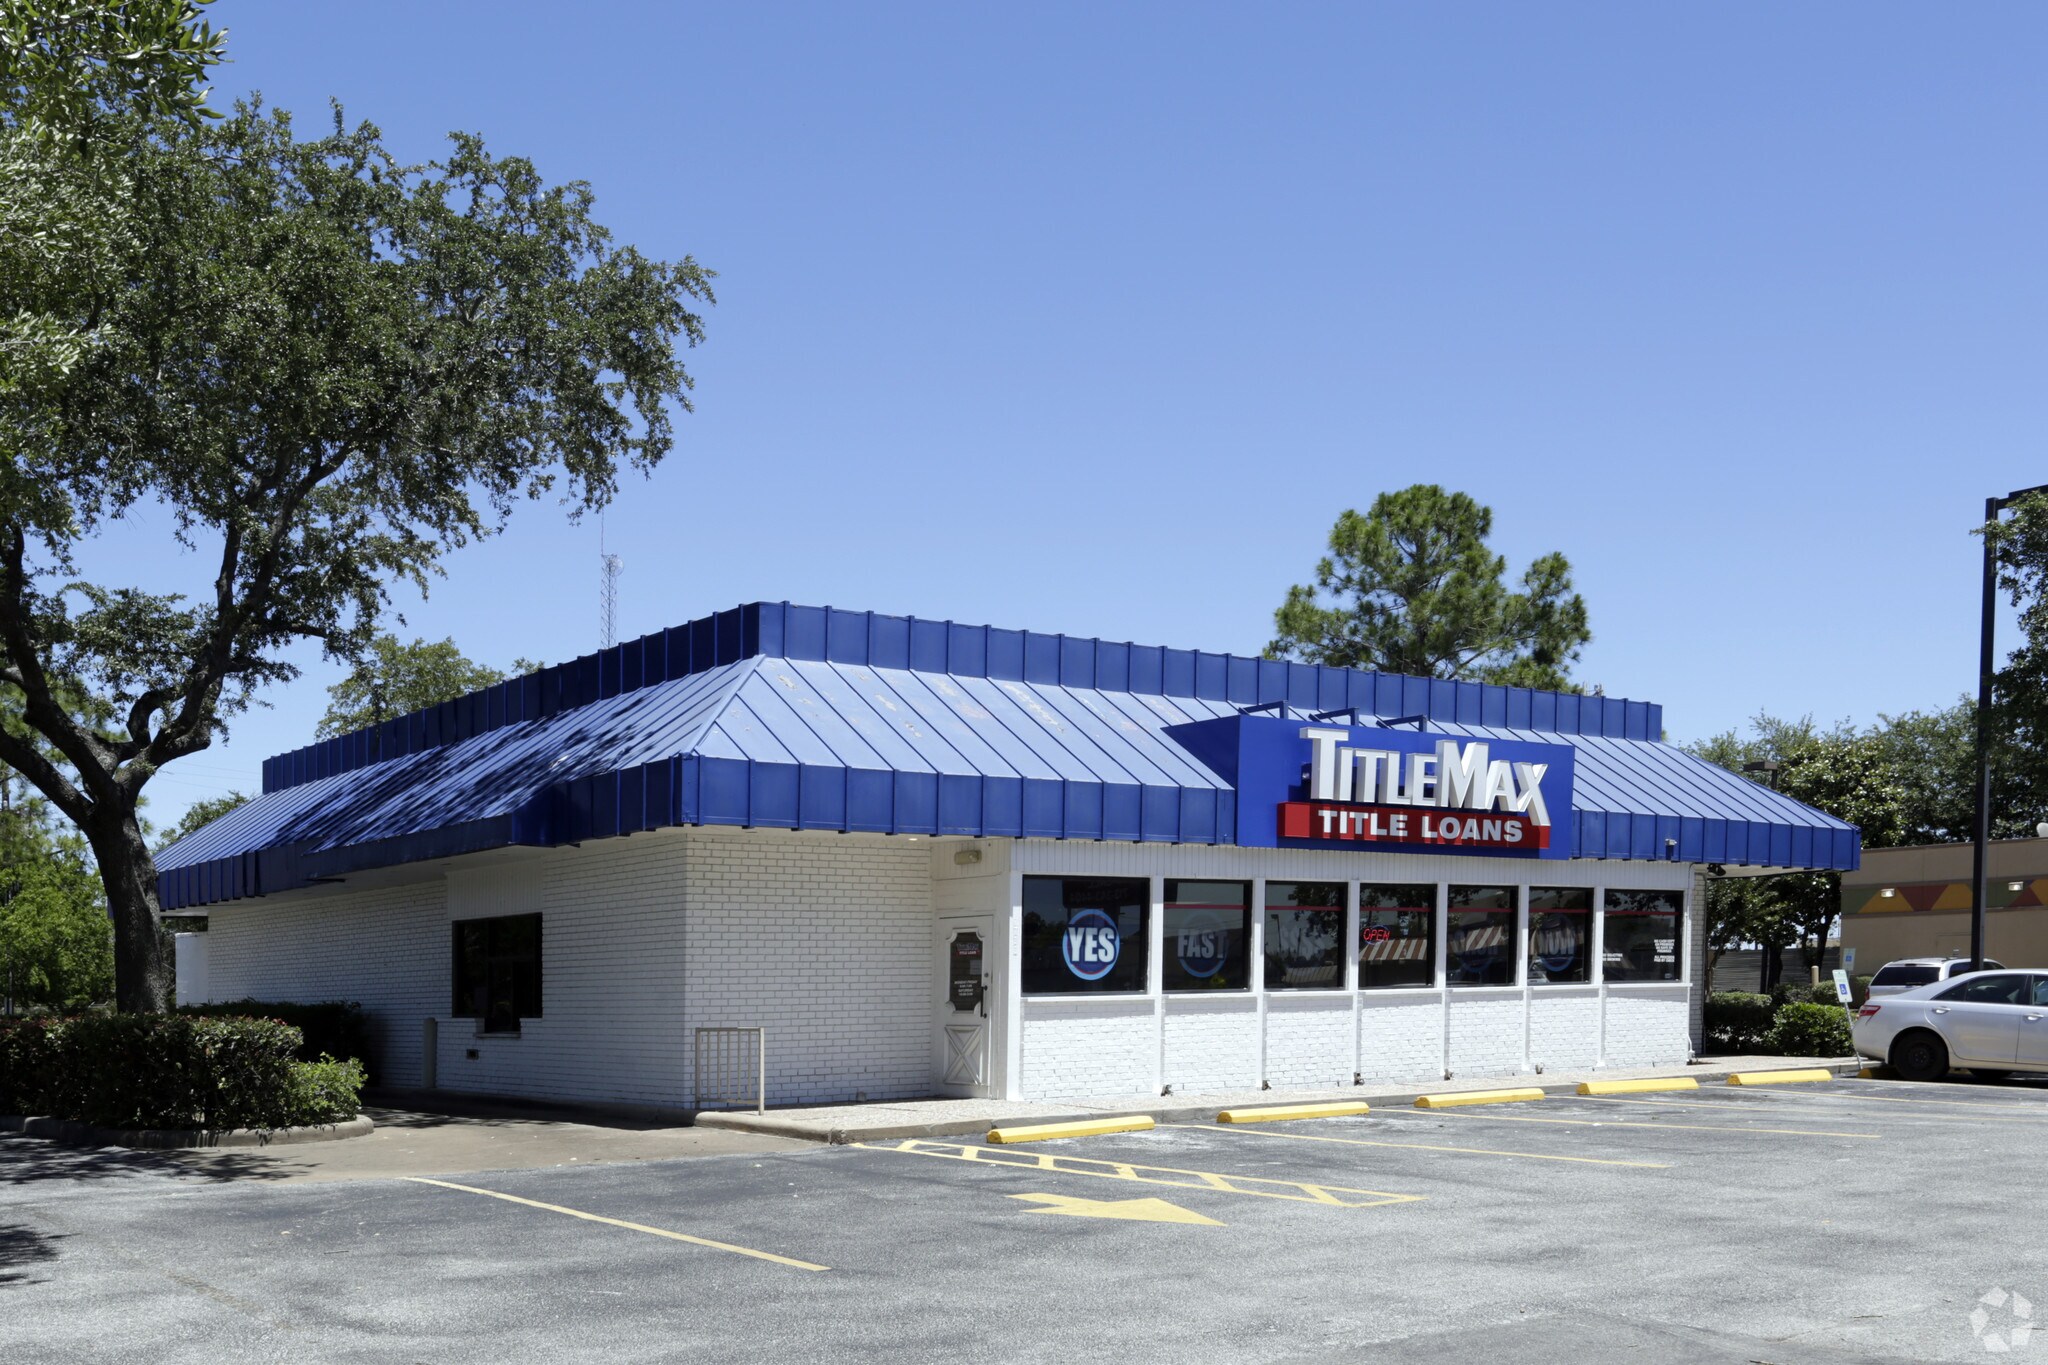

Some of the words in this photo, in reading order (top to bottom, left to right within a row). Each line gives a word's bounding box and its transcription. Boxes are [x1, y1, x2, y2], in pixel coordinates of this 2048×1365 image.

[1318, 810, 1408, 836] TITLE
[1421, 816, 1523, 842] LOANS
[1068, 926, 1115, 963] YES
[1177, 928, 1228, 960] FAST
[1363, 928, 1391, 941] OPEN
